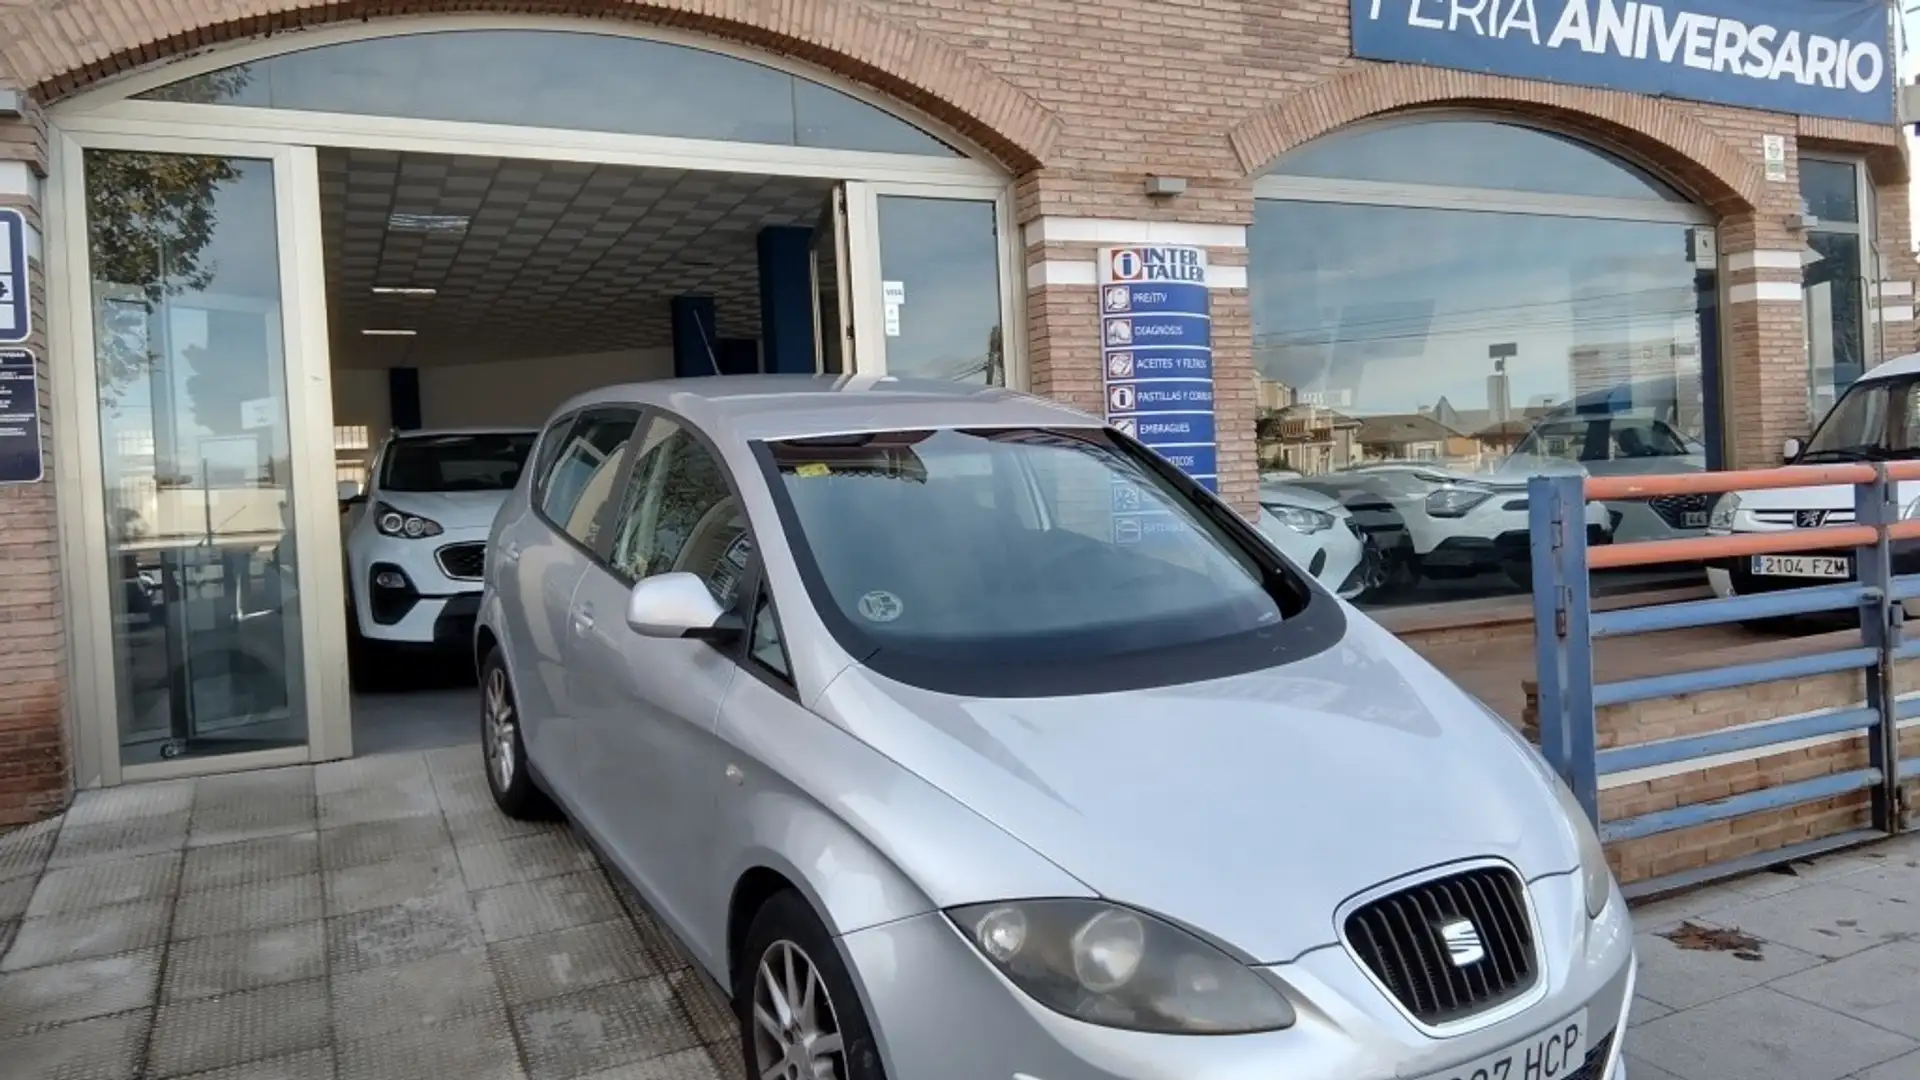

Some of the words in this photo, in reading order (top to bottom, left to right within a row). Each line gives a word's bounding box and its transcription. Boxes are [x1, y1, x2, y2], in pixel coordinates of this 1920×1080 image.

[1547, 0, 1884, 93] ANIVERSARIO
[1143, 247, 1198, 266] INTER
[1143, 264, 1205, 282] TALLER
[1134, 325, 1184, 336] DIAGNOSIS
[1136, 357, 1173, 369] ACEITES
[1137, 390, 1181, 402] PASTILLAS
[1139, 422, 1191, 435] EMBRAGUES
[1765, 557, 1804, 574] 2104
[1812, 558, 1846, 575] FZM
[1524, 1023, 1578, 1080] HCP
